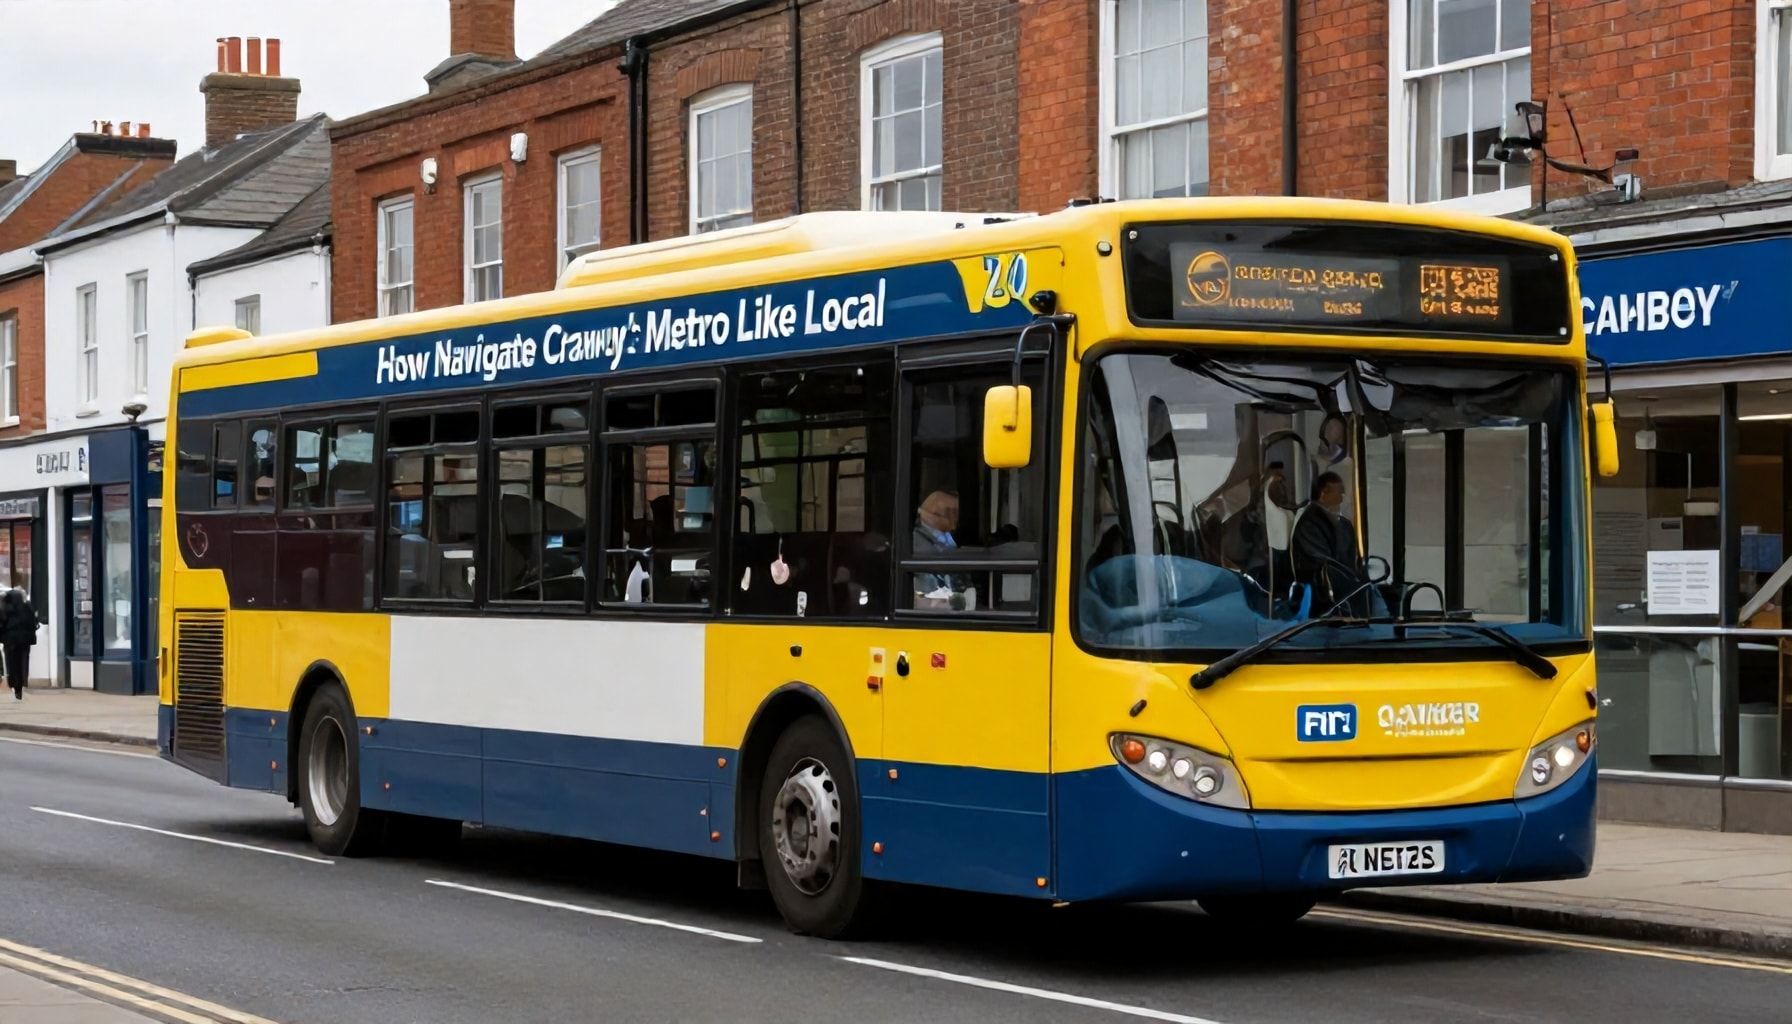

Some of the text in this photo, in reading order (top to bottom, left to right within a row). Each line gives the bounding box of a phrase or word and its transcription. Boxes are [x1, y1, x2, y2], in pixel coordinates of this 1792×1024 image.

[376, 344, 431, 384] How
[434, 333, 537, 381] Navigate
[645, 308, 729, 354] Metro
[737, 294, 797, 342] Like
[804, 277, 886, 334] Local
